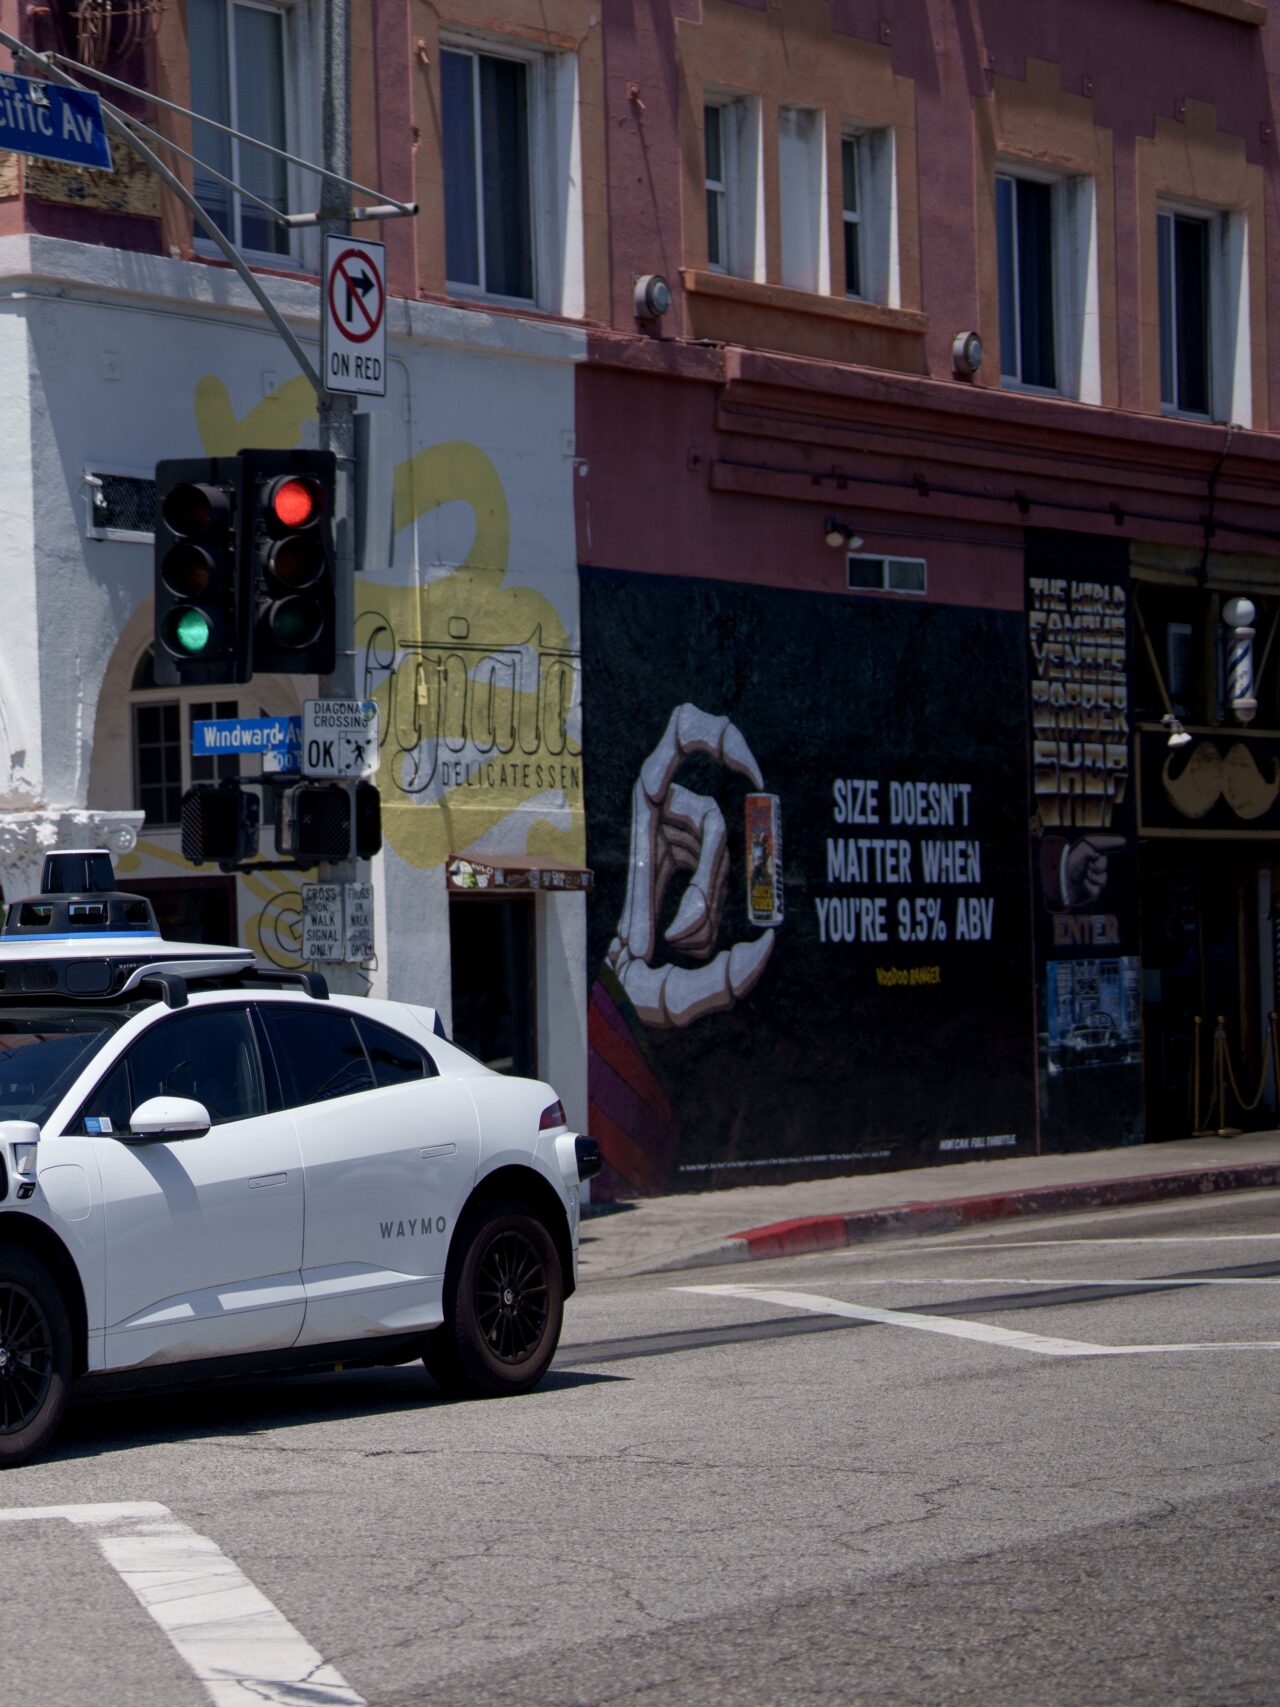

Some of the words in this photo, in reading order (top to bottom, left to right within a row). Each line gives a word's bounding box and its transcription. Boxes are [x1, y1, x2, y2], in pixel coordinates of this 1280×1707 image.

[62, 103, 94, 145] Av
[332, 352, 349, 377] ON
[355, 356, 381, 381] RED
[1028, 577, 1068, 611] THE
[1029, 611, 1127, 645] FAMOUS
[1030, 643, 1128, 679] VENICE
[314, 703, 361, 714] DIAGONA
[204, 723, 280, 748] Windward
[308, 740, 334, 768] OK
[442, 762, 580, 788] DELICATESSEN
[1033, 741, 1129, 803] SHOP
[833, 778, 879, 824] SIZE
[890, 781, 972, 826] DOESN'T
[826, 838, 912, 883] MATTER
[921, 840, 981, 883] WHEN
[307, 888, 336, 900] CROSS
[311, 914, 335, 926] WALK
[815, 897, 888, 942] YOU'RE
[897, 897, 947, 941] 9.5%
[955, 897, 994, 940] ABV
[1053, 913, 1119, 945] ENTER
[306, 930, 338, 941] SIGNAL
[310, 944, 334, 956] ONLY
[379, 1216, 446, 1239] WAYMO
